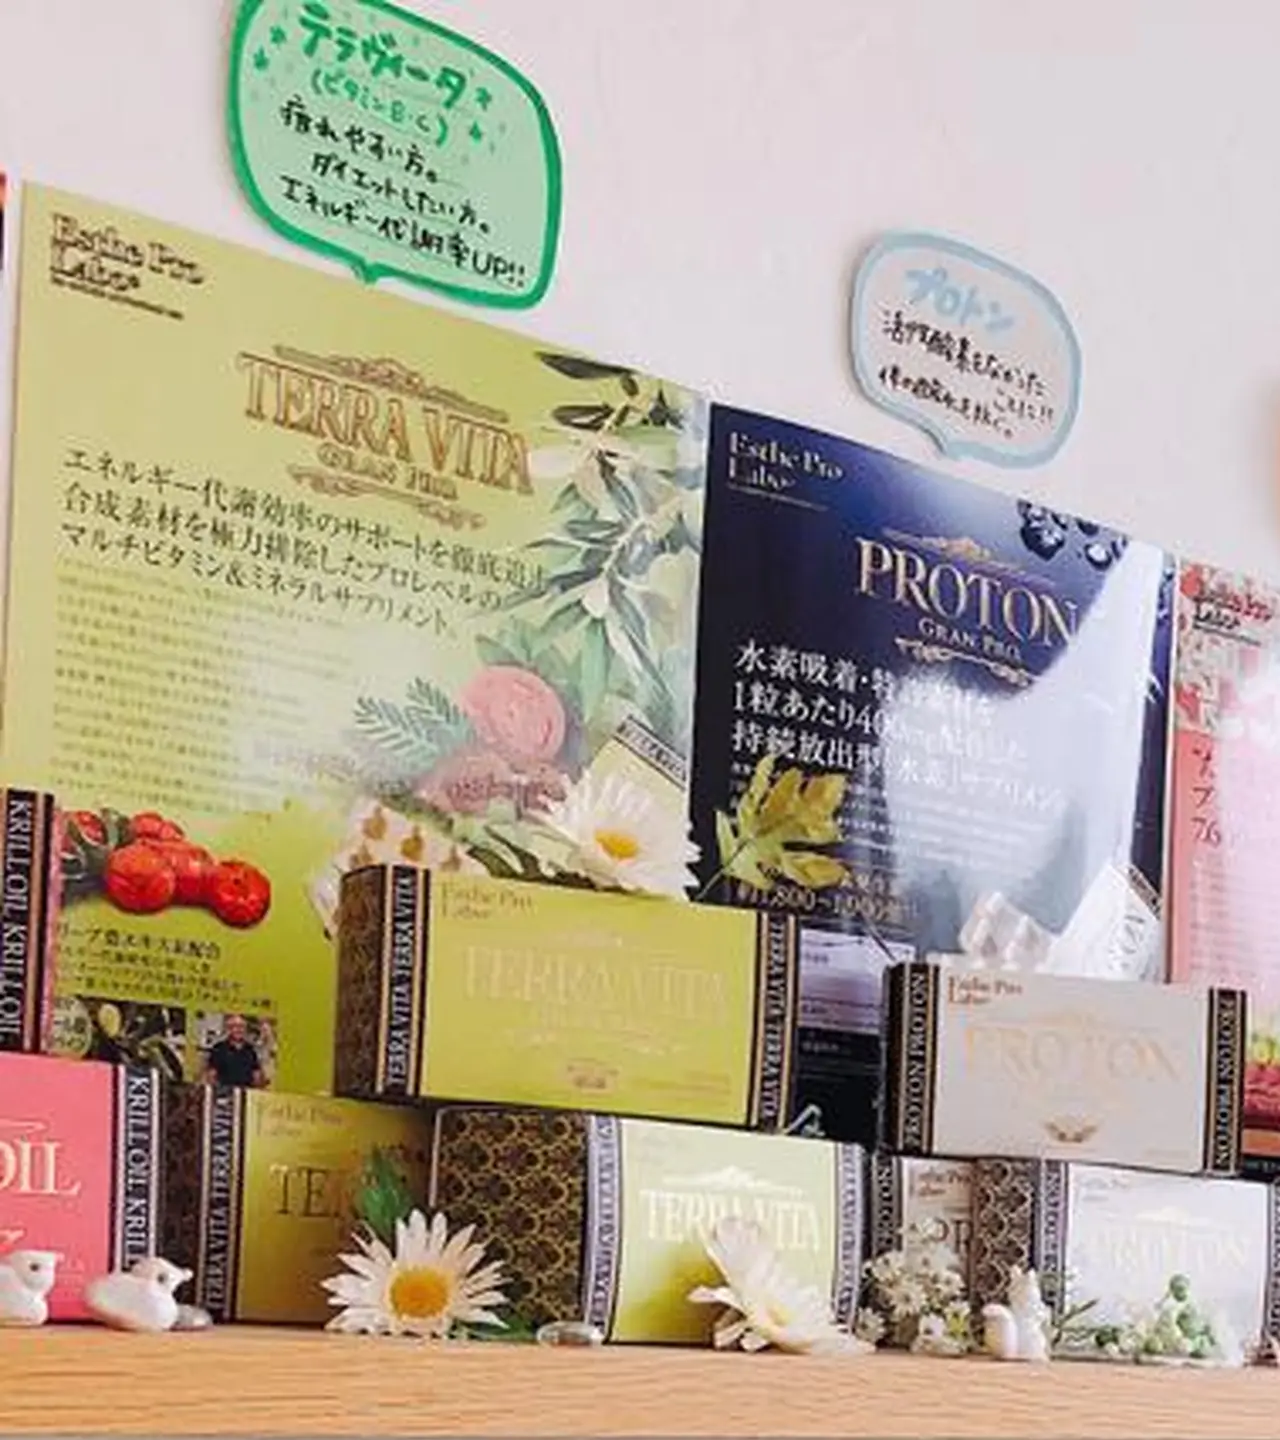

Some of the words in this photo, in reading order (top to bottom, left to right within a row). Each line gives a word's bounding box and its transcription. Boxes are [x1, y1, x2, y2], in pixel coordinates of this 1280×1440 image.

[300, 3, 465, 108] テラヴィータ
[240, 352, 412, 464] TERRA
[422, 403, 534, 496] VITA
[855, 536, 1080, 649] PROTON
